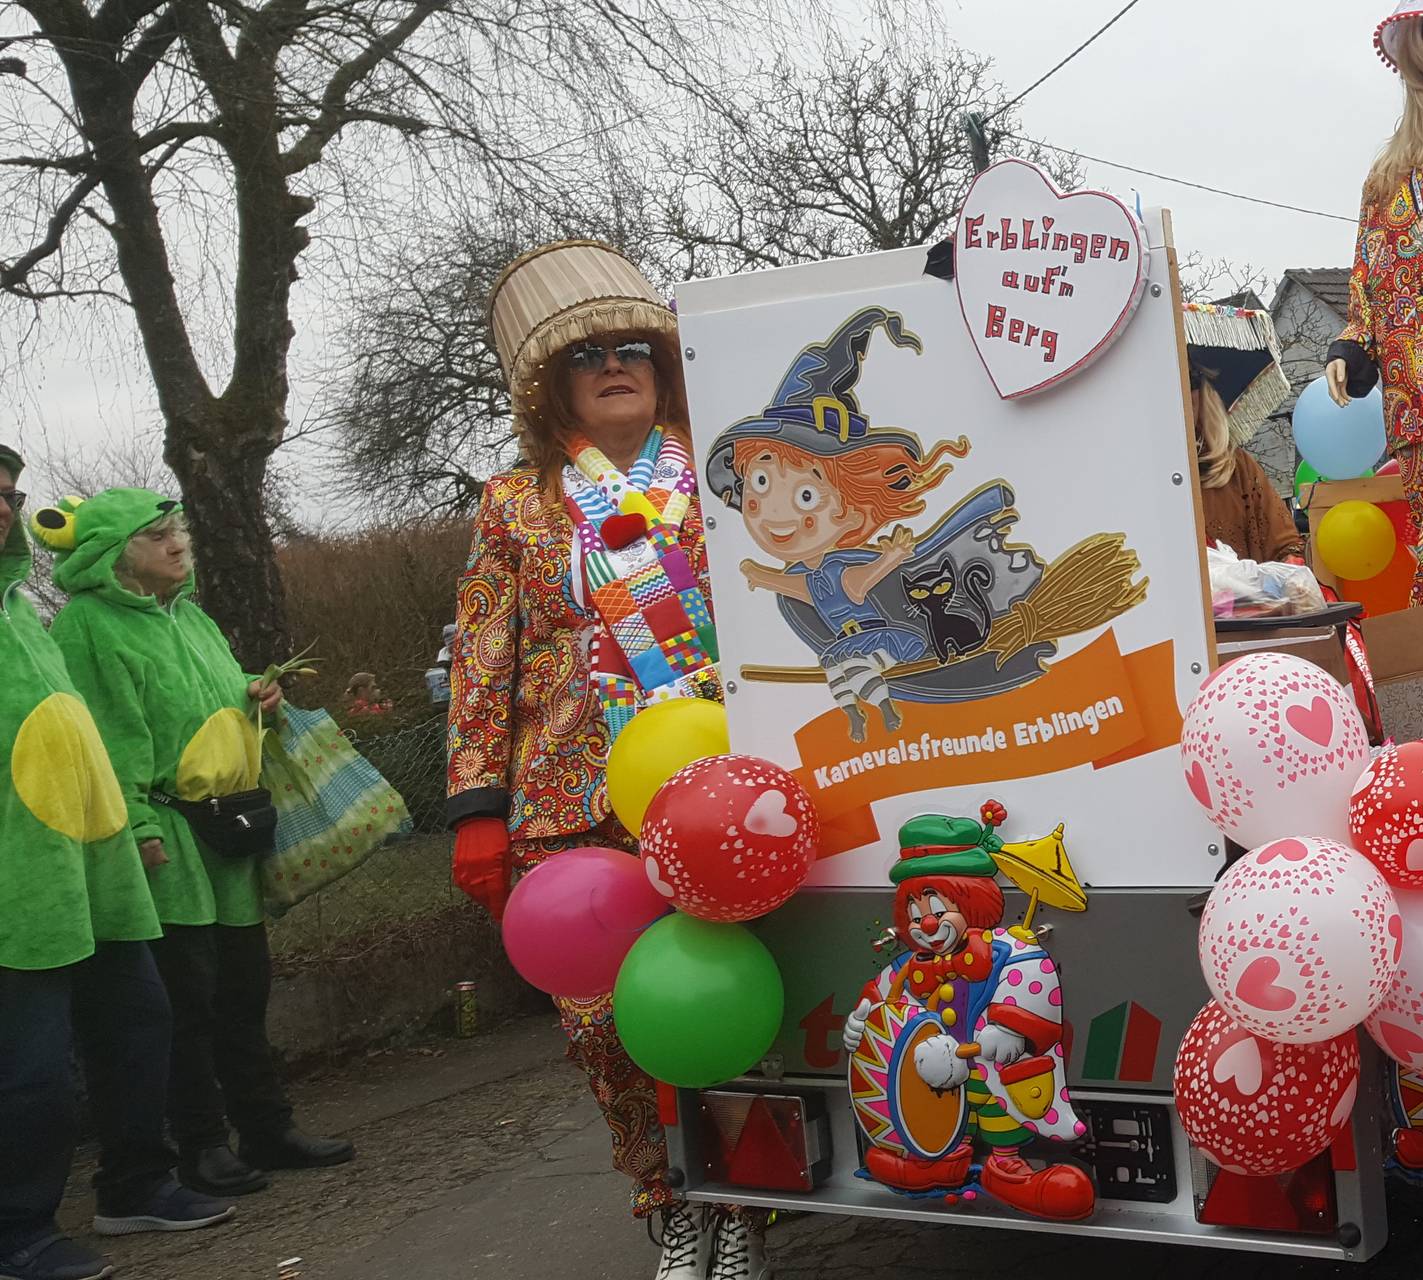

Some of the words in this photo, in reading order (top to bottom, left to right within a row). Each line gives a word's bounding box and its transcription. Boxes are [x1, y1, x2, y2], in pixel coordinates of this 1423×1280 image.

[985, 303, 1059, 362] Berg
[813, 726, 1007, 789] Karnevalsfreunde
[1014, 695, 1124, 746] Erblingen
